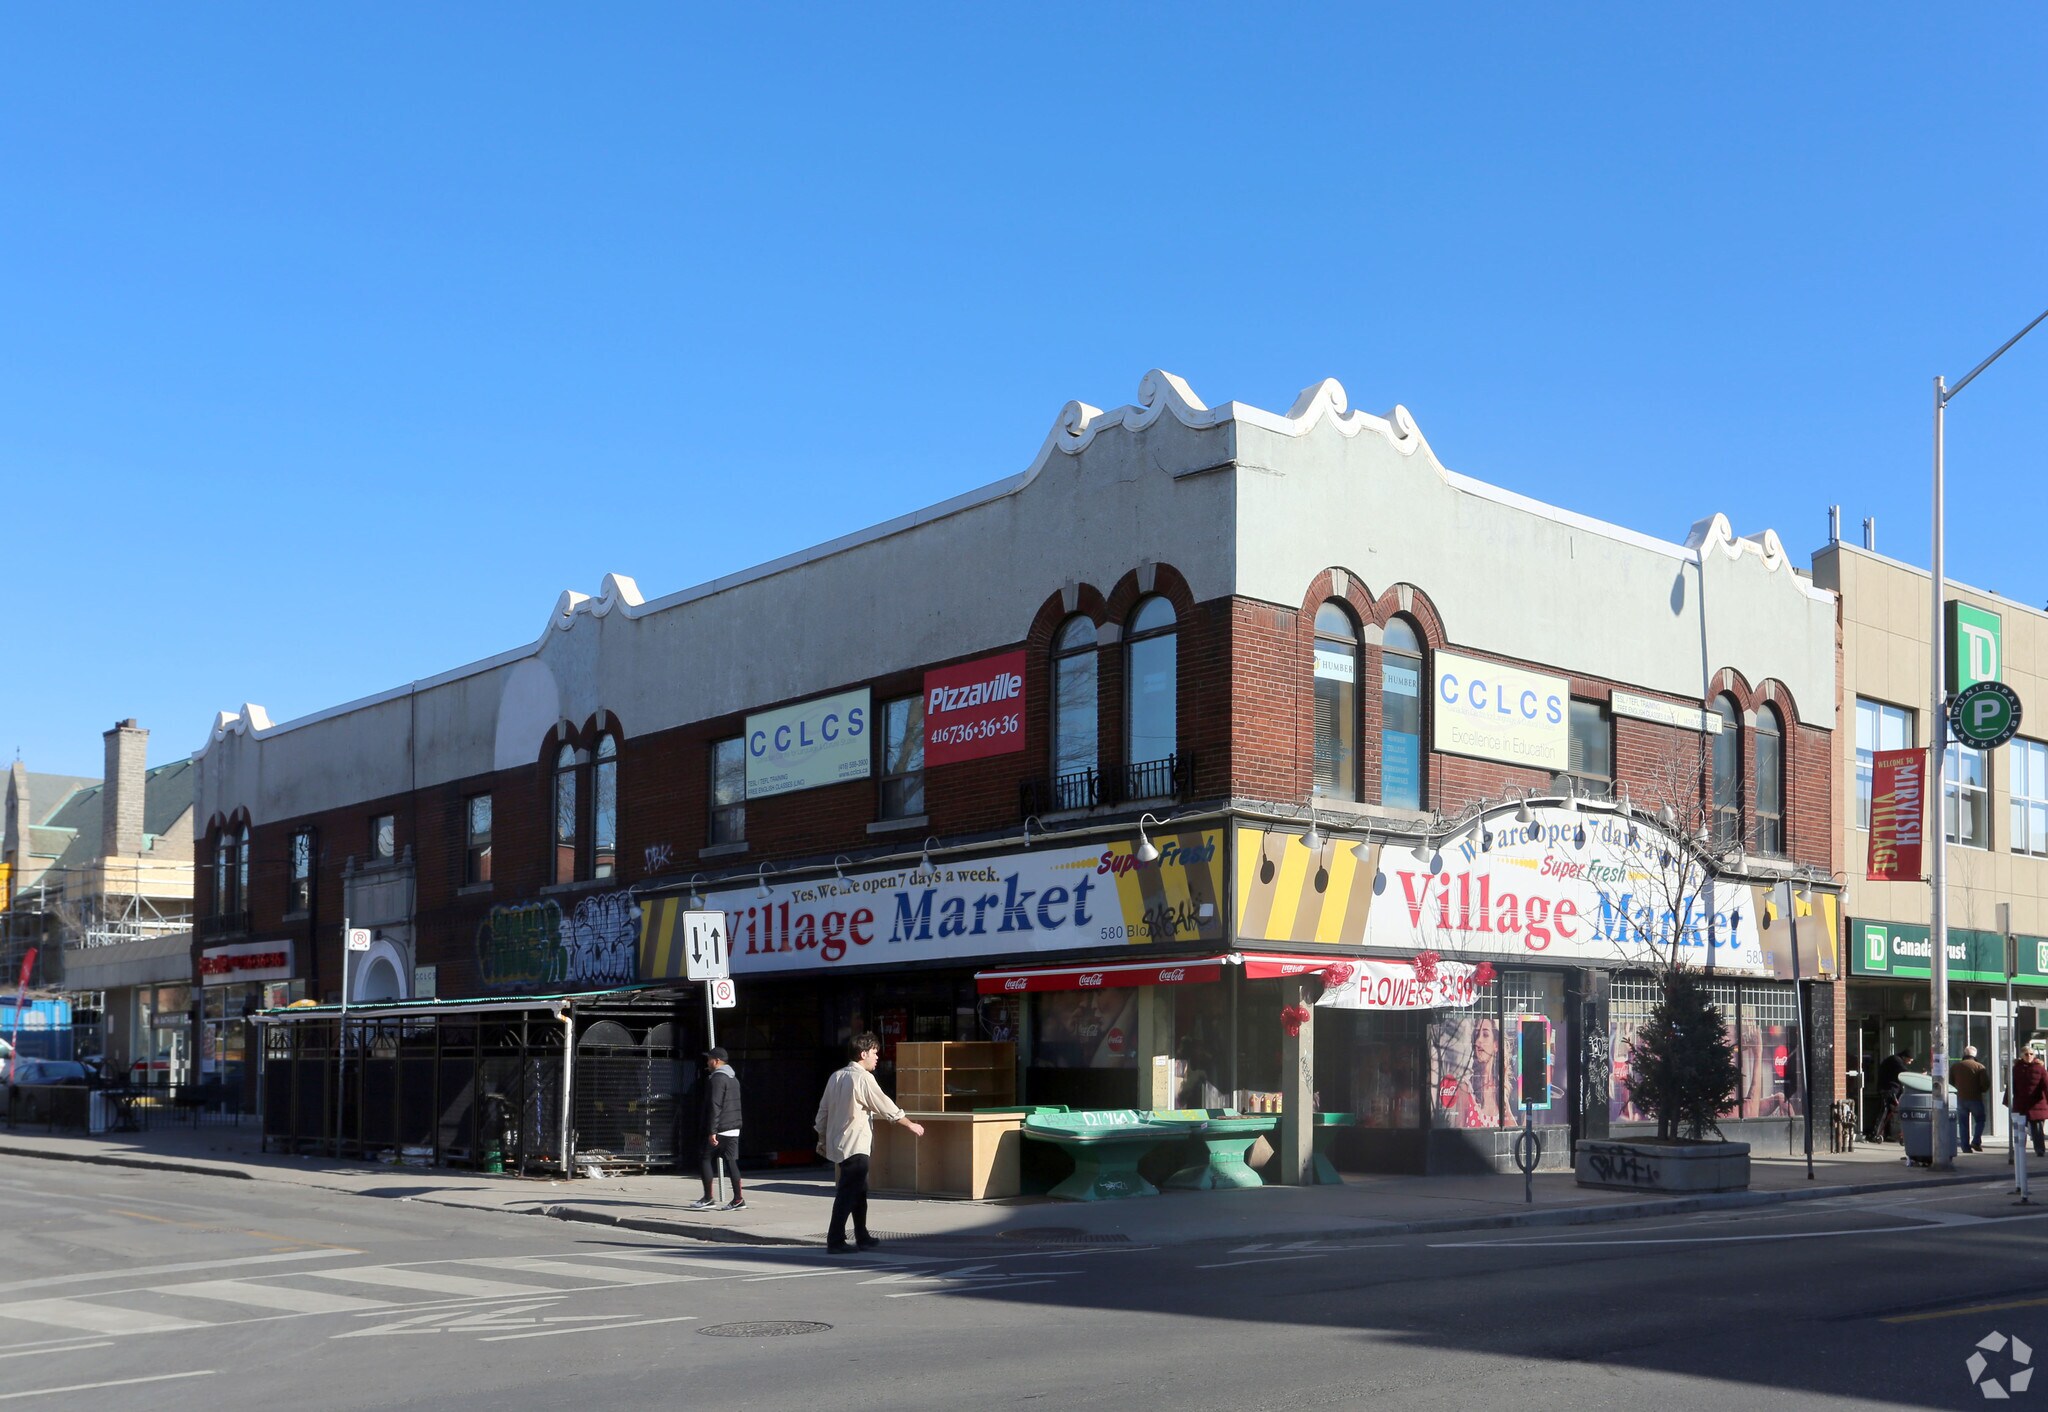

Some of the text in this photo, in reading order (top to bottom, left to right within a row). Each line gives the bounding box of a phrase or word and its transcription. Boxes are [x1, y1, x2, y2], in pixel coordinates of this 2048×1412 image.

[1322, 659, 1353, 674] HUMBER
[1962, 622, 1997, 683] TD
[928, 671, 1022, 715] Pizzaville
[1388, 674, 1417, 688] HUMBER
[1440, 673, 1562, 724] CCLCS
[1953, 683, 2018, 716] MUNICIPAL
[1974, 699, 2001, 726] P
[750, 707, 864, 757] CCLCS
[1452, 726, 1556, 759] Excellence in Education
[1953, 719, 2018, 748] PARKING
[1877, 756, 1914, 768] WELCOME TO
[1894, 764, 1920, 846] MIRVISH
[1497, 826, 1531, 848] are
[1536, 823, 1586, 849] open
[1589, 819, 1599, 843] 7
[1872, 791, 1898, 874] VILLAGE
[1157, 835, 1215, 868] Fresh
[862, 875, 896, 894] open
[898, 873, 906, 888] 7
[909, 869, 942, 887] days
[946, 871, 954, 882] a
[958, 866, 1000, 882] week.
[1541, 855, 1627, 884] Super Fresh
[888, 872, 1095, 943] Market
[1396, 871, 1743, 951] Village Market
[1101, 925, 1123, 939] 580
[1867, 934, 1885, 961] TD
[1946, 942, 1966, 960] rust
[1746, 949, 1764, 965] 580
[1359, 975, 1433, 1007] FLOWERS
[1911, 1111, 1927, 1119] Litter
